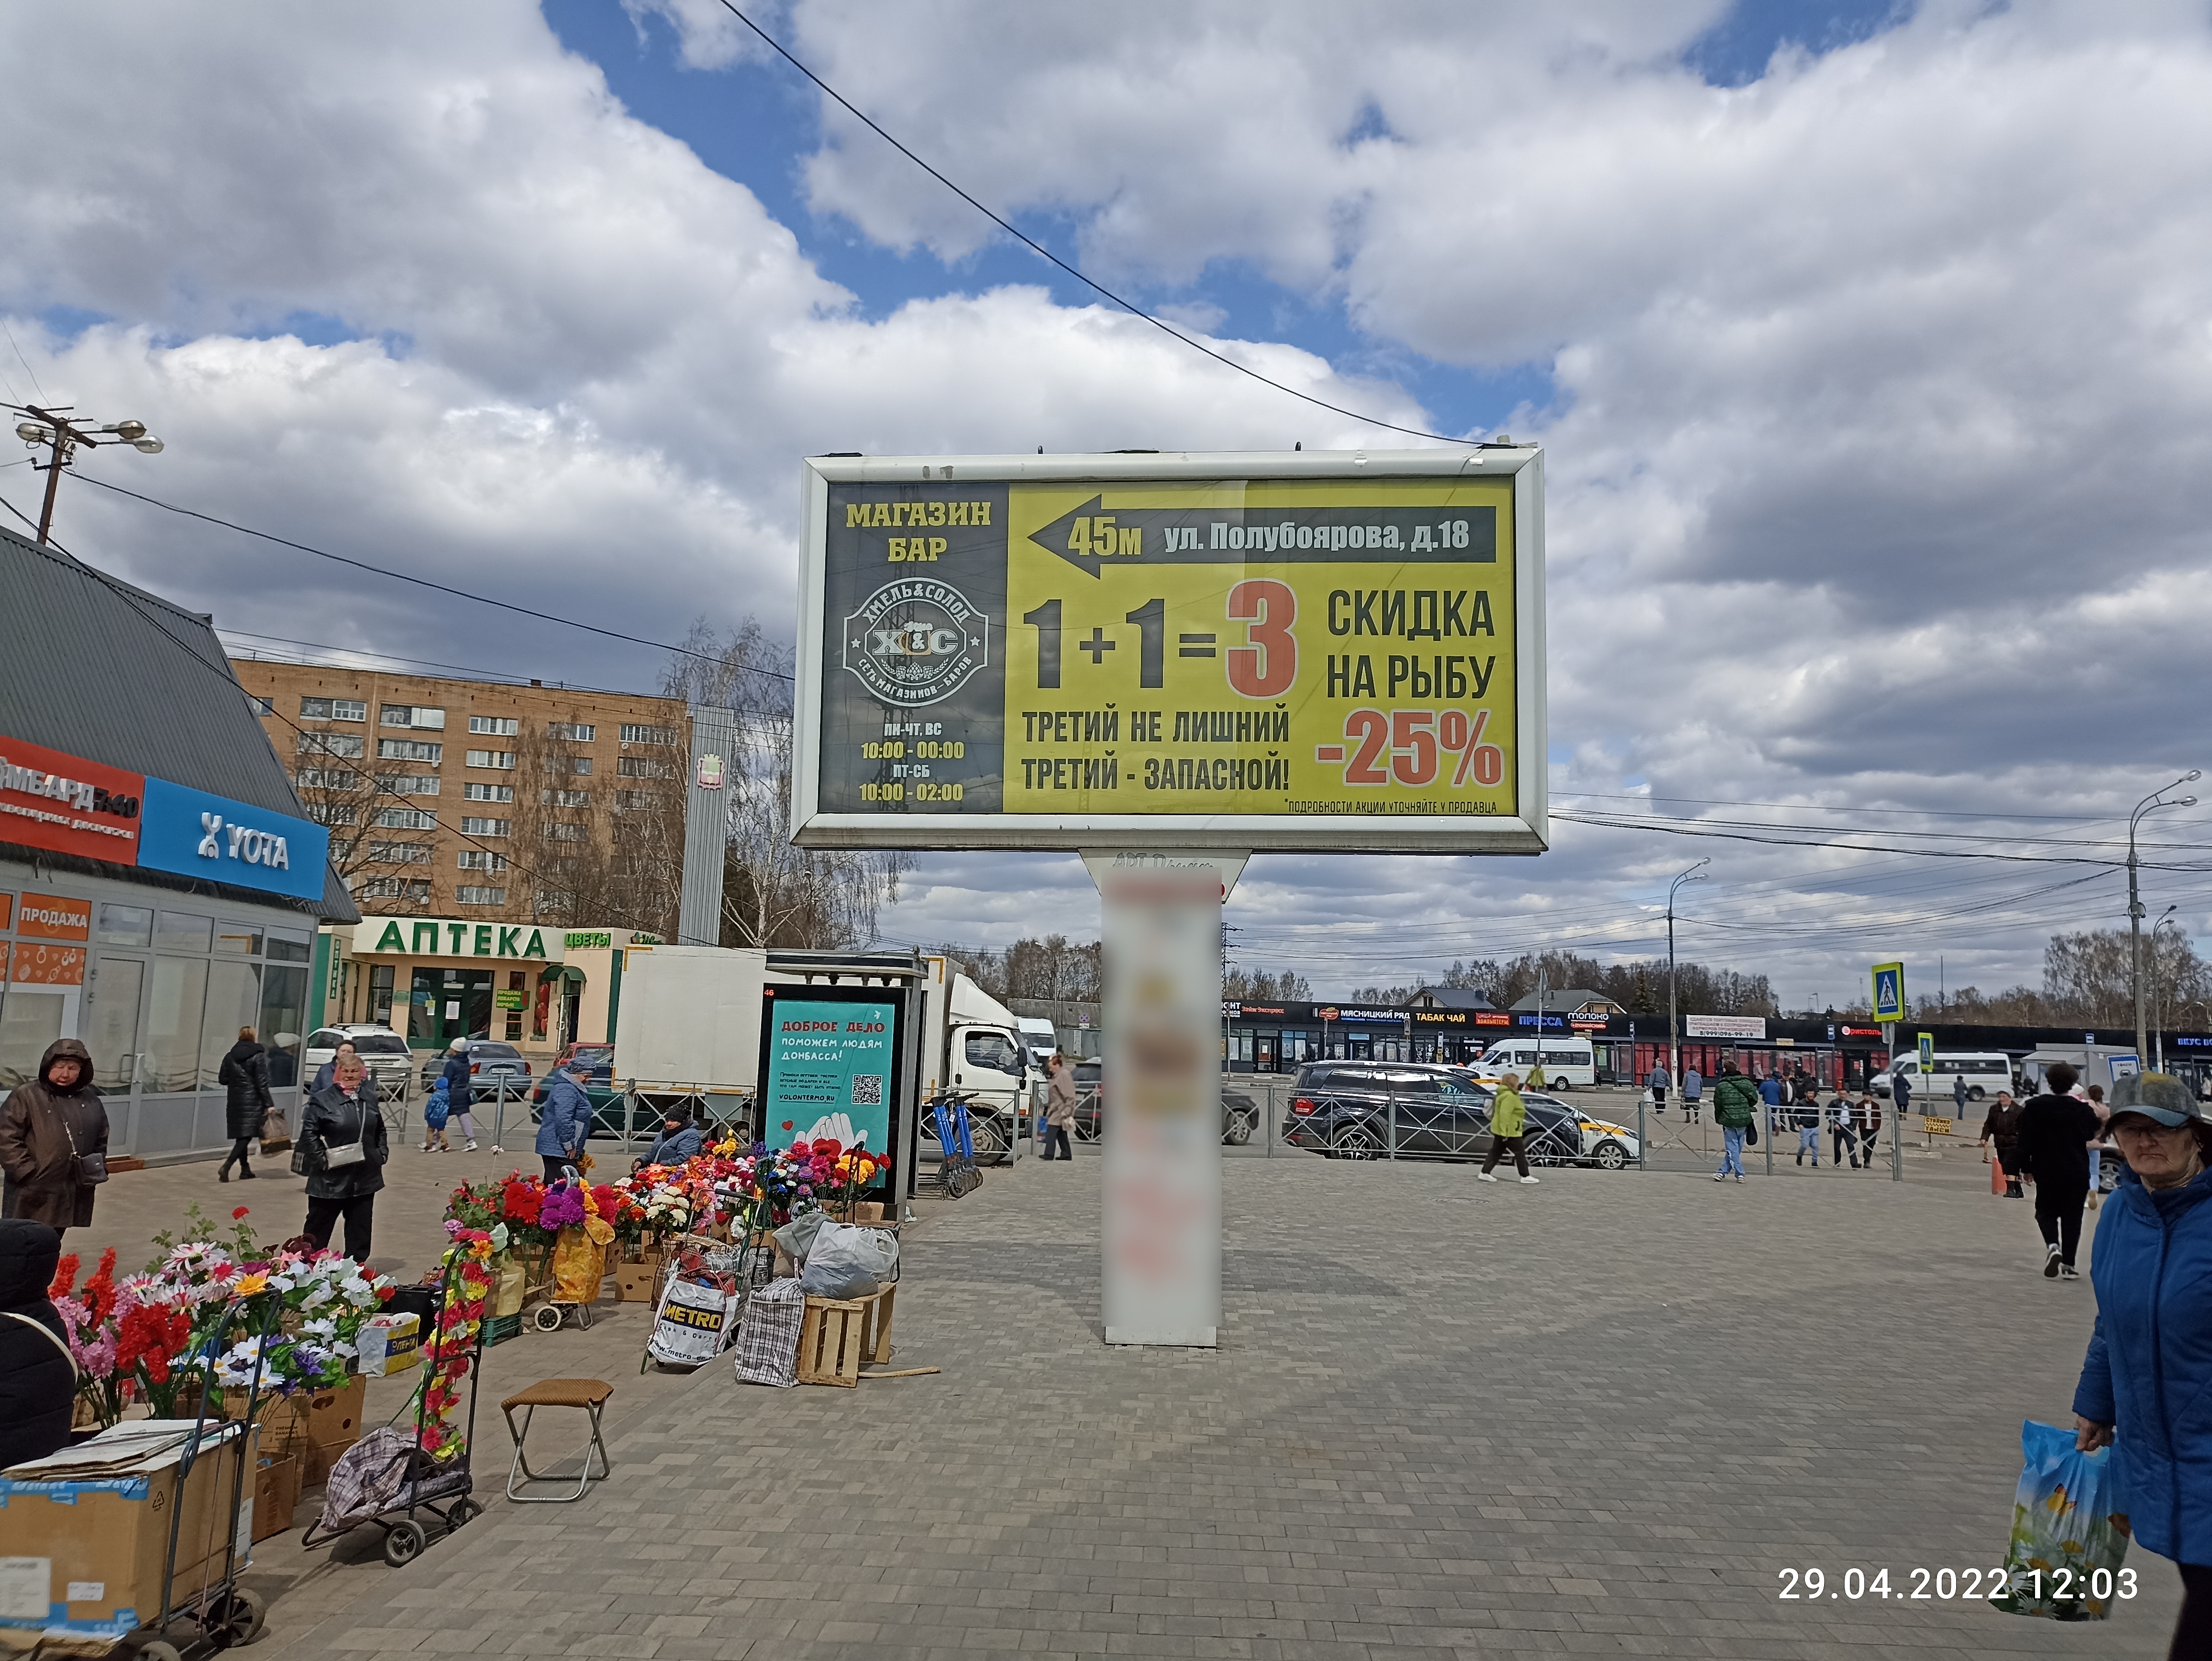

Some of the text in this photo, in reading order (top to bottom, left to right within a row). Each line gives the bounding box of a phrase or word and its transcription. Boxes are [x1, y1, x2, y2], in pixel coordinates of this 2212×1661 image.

[846, 502, 991, 528] МАГАЗИН
[1164, 527, 1204, 553] ул.
[1211, 522, 1406, 553] Полубоярова,
[1411, 520, 1470, 553] д.18
[888, 538, 947, 562] БАР
[1327, 589, 1495, 642] СКИДКА
[858, 658, 876, 682] СЕТЬ
[1327, 655, 1496, 699] НА РЫБУ
[884, 723, 942, 737] ПН-ЧТ, ВС
[1022, 703, 1289, 742] ТРЕТИЙ НЕ ЛИШНИЙ
[861, 742, 904, 759] 10:00
[917, 742, 964, 759] 00:00
[1316, 708, 1505, 788] -25%
[893, 764, 930, 778] ПТ-СБ
[1021, 750, 1118, 790] ТРЕТИЙ
[1145, 750, 1290, 790] ЗАПАСНОЙ!
[0, 756, 95, 813] МБАРД
[859, 784, 904, 801] 10:00
[916, 784, 963, 801] 02:00
[1356, 801, 1386, 814] АКЦИИ
[1389, 798, 1437, 814] УТОЧНЯЙТЕ
[1440, 802, 1446, 813] У
[1449, 802, 1497, 814] ПРОДАВЦА
[226, 823, 289, 870] YOTA
[21, 907, 88, 928] ПРОДАЖА
[375, 920, 546, 958] АПТЕКА
[565, 933, 611, 947] ЦВЕТЫ
[1340, 1009, 1393, 1019] МЯСНИЦКИЙ
[1416, 1013, 1465, 1022] ТАБАК ЧАЙ
[1519, 1016, 1563, 1027] ПРЕССА
[781, 1020, 885, 1033] ДОБРОЕ ДЕЛО
[781, 1038, 883, 1049] ПОМОЖЕМ ЛЮДЯМ
[781, 1050, 842, 1062] ДОНБАССА!
[779, 1094, 835, 1102] VOLONTERMO.RU
[664, 1303, 721, 1329] METRO
